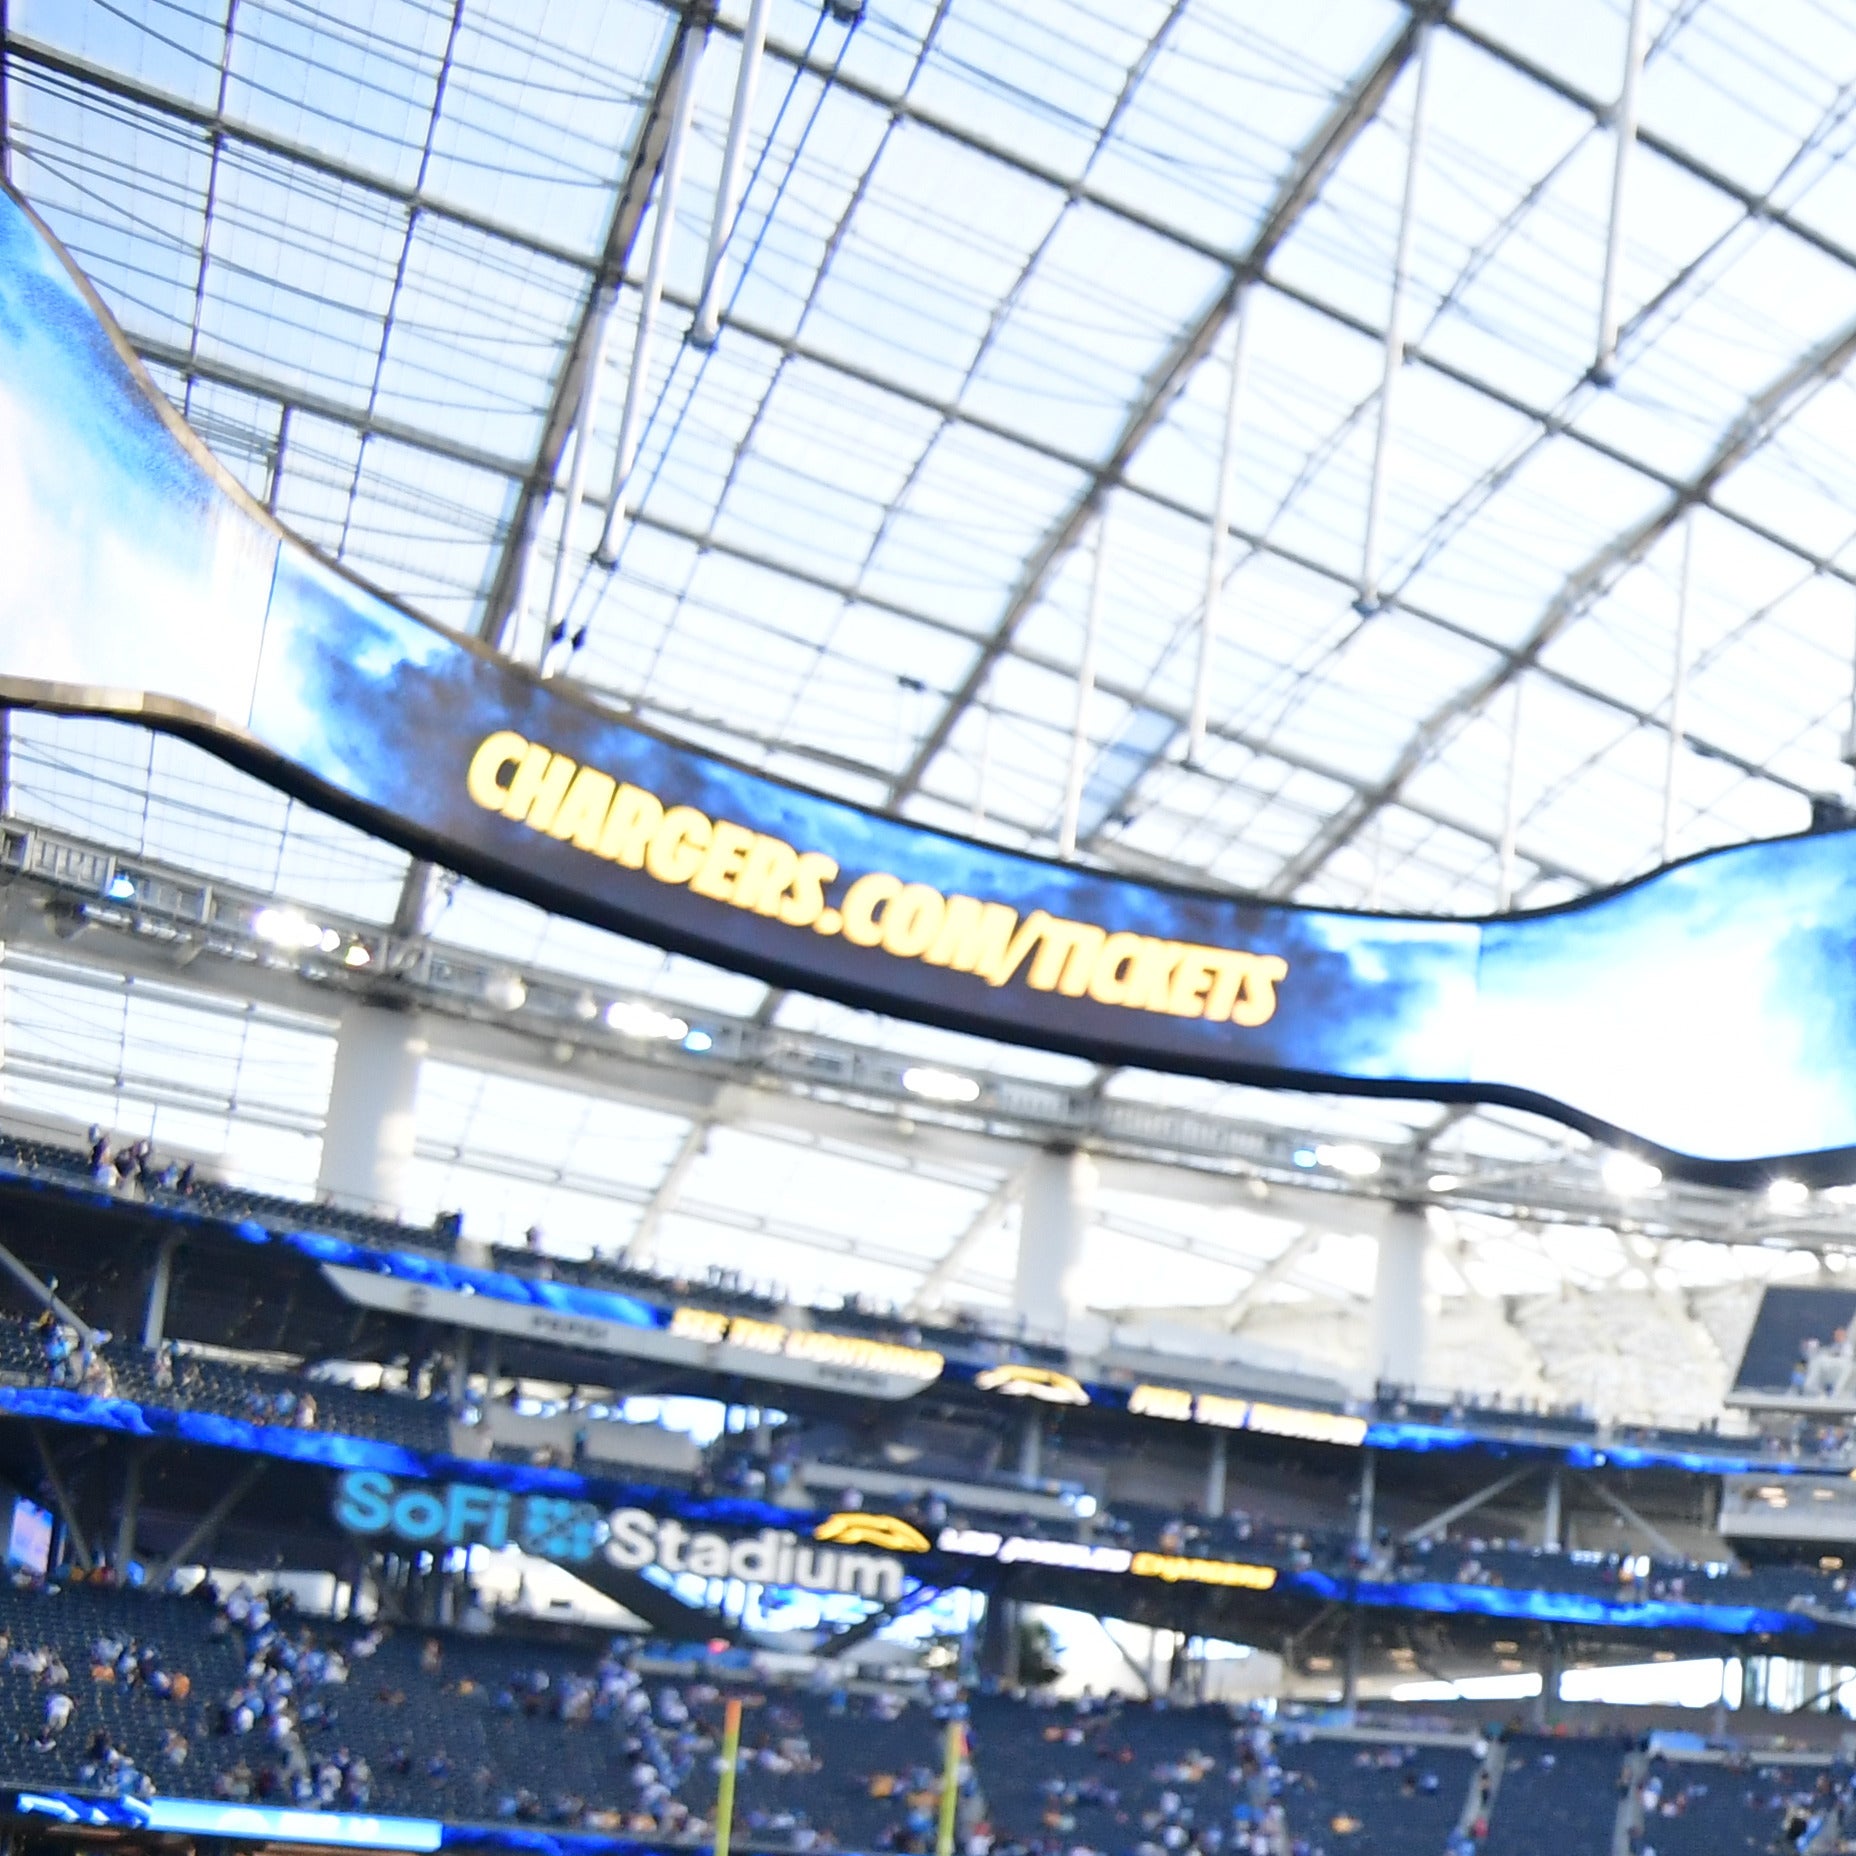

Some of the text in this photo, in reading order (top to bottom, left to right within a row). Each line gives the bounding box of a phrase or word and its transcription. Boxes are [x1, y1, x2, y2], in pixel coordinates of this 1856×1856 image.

[466, 729, 1289, 1028] CHARGERS.COM/TICKETS
[335, 1470, 906, 1601] SoFi Stadium
